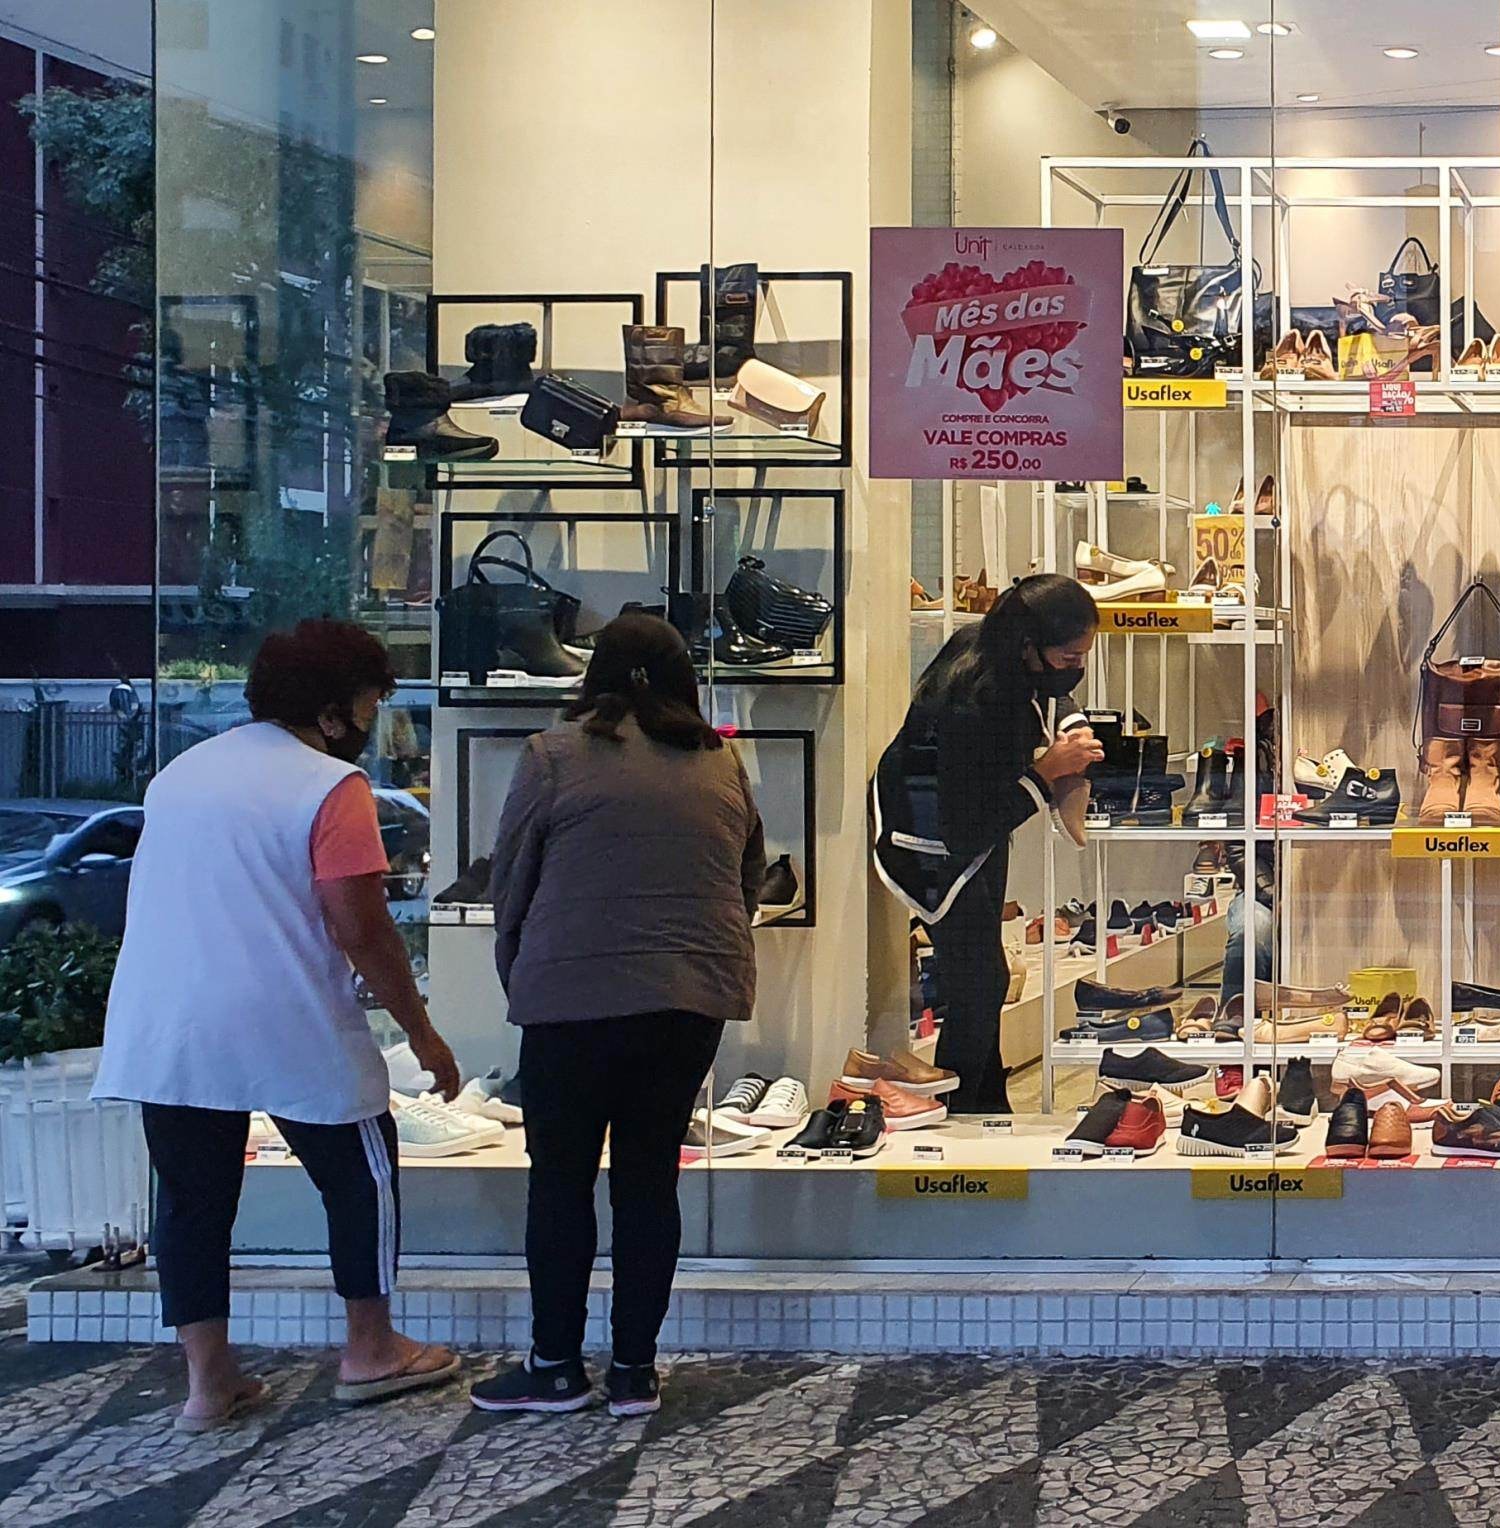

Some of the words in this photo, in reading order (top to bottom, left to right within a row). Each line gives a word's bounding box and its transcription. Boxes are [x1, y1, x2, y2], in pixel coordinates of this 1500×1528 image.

[955, 231, 992, 261] Unit
[935, 299, 999, 333] Mês
[1004, 292, 1065, 321] das
[904, 333, 1083, 391] Mães
[1127, 385, 1193, 402] Usaflex
[942, 414, 984, 424] COMPRE
[985, 414, 991, 424] E
[993, 414, 1049, 424] CONCORRA
[923, 430, 973, 446] VALE
[976, 430, 1068, 446] COMPRAS
[950, 457, 967, 471] R$
[971, 450, 1042, 471] 250,00
[1113, 612, 1179, 627] Usaflex
[1425, 836, 1489, 852] Usaflex
[914, 1175, 989, 1195] Usaflex
[1229, 1174, 1304, 1193] Usaflex
